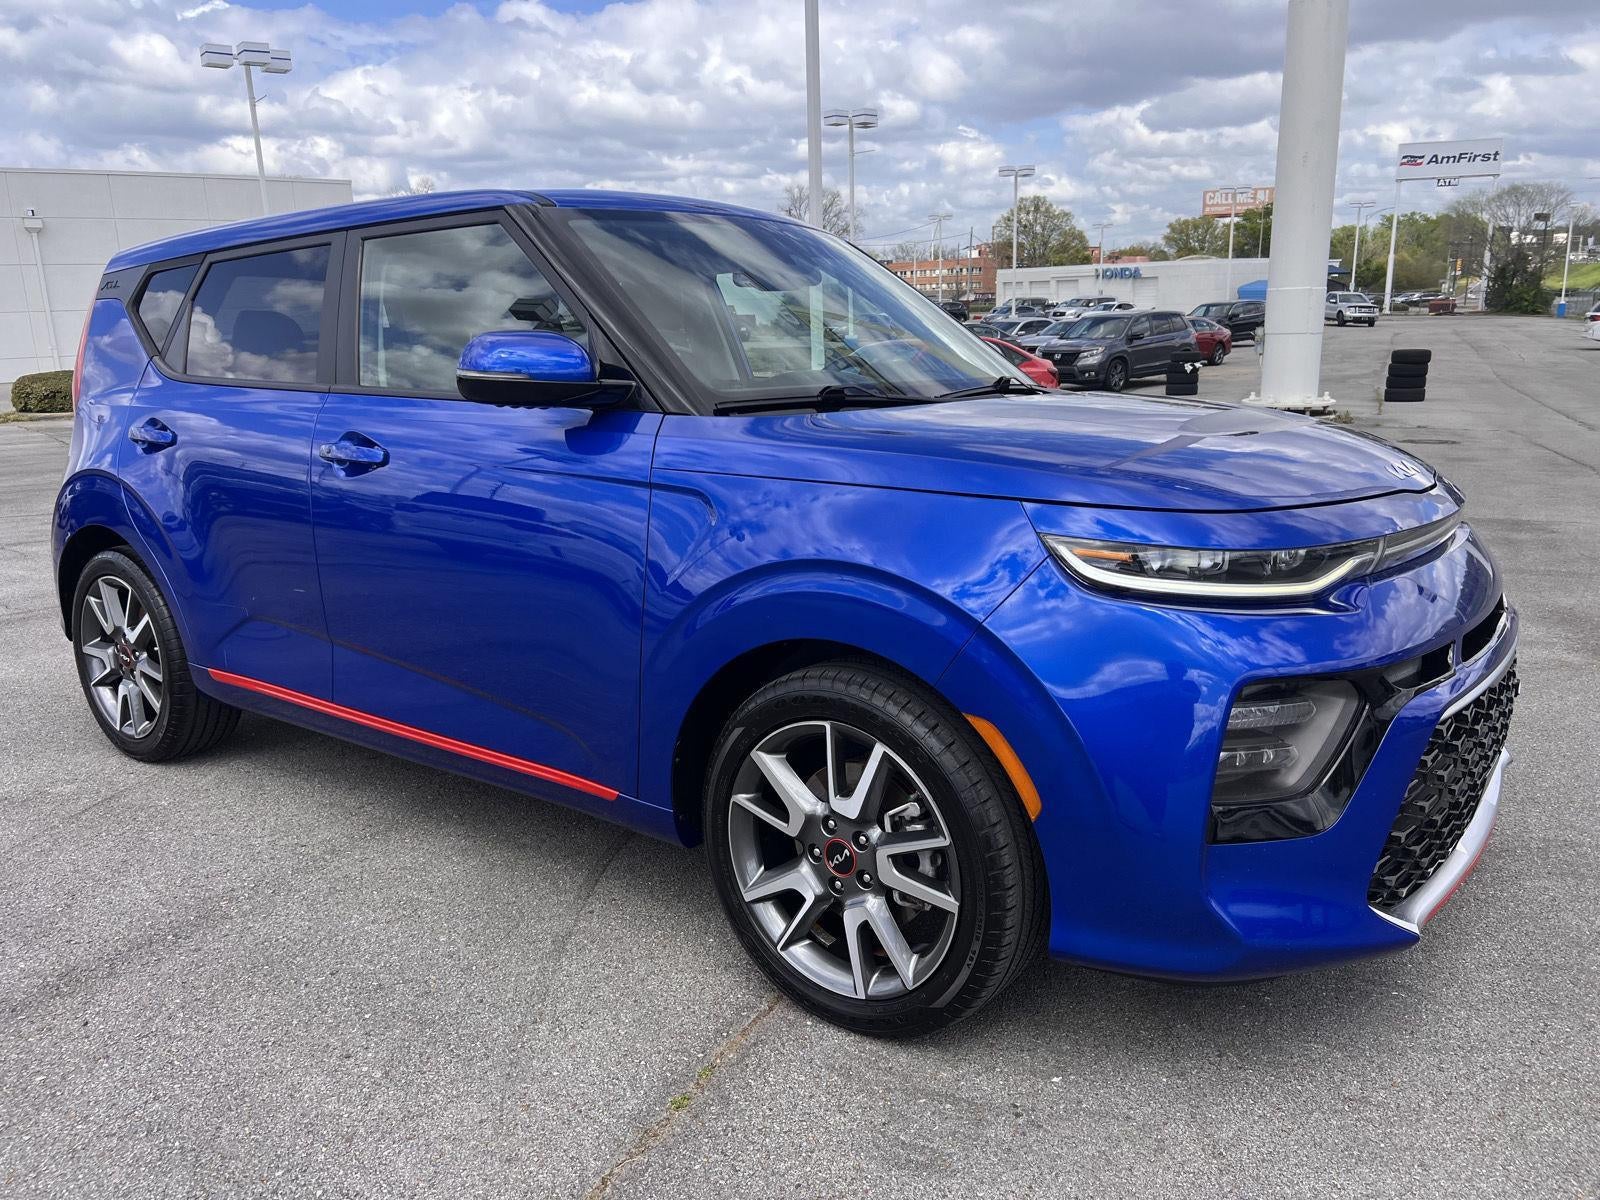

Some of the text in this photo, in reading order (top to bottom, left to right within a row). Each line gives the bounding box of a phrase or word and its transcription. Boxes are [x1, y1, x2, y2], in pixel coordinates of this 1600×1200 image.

[1426, 150, 1500, 166] AmFirst
[1437, 178, 1458, 187] ATM
[1206, 191, 1233, 205] CALL
[1095, 266, 1142, 279] HONDA
